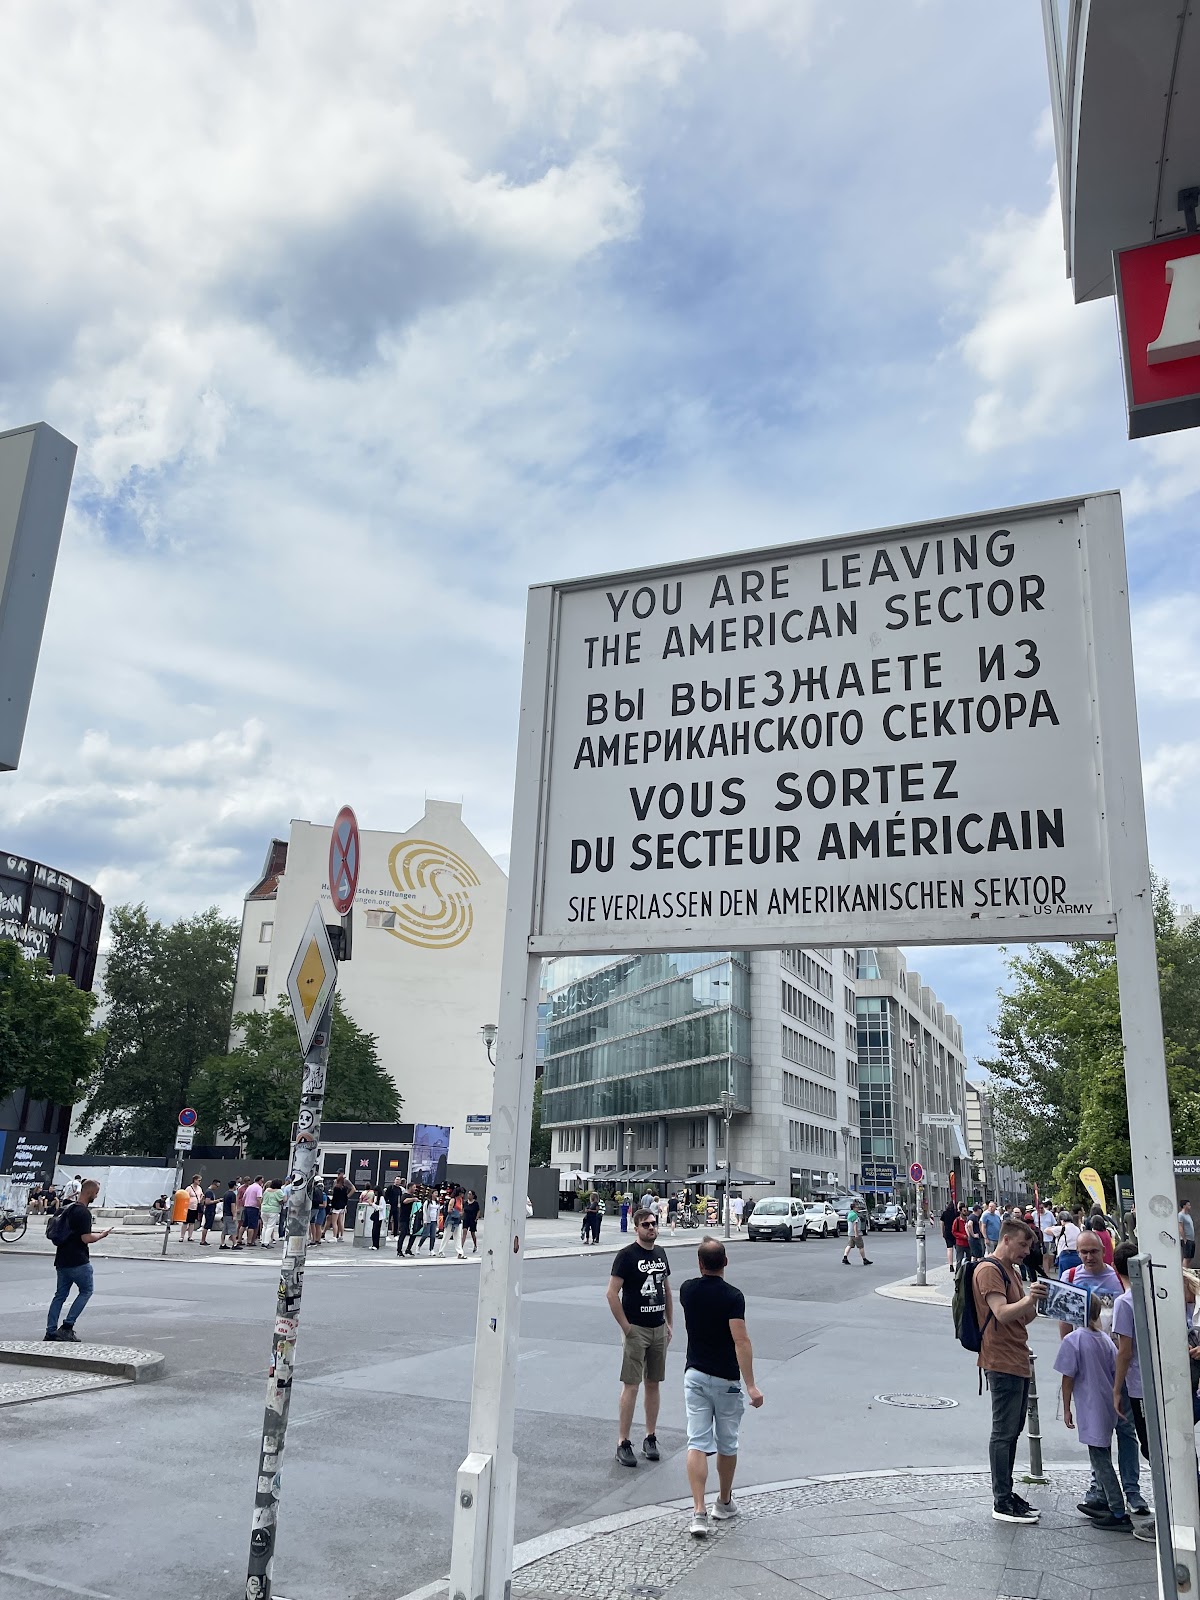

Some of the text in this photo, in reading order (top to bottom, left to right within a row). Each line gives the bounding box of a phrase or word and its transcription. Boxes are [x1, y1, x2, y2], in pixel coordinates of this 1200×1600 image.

[606, 529, 1015, 623] YOU ARE LEAVING
[584, 574, 1045, 669] THE AMERICAN SECTOR
[586, 638, 1041, 726] ВЫ ВЫЕЗЖАЕТЕ ИЗ
[573, 689, 1061, 770] АМЕРИКАНСКОГО СЕКТОРА
[628, 759, 960, 822] VOUS SORTEZ
[570, 808, 1066, 875] DU SECTEUR AMÉRICAIN
[378, 888, 417, 900] Stiftungen
[567, 875, 1068, 923] SIE VERLASSEN DEN AMERIKANISCHEN SEKTOR
[1033, 904, 1093, 916] US ARMY
[637, 1257, 667, 1274] Carlsberg
